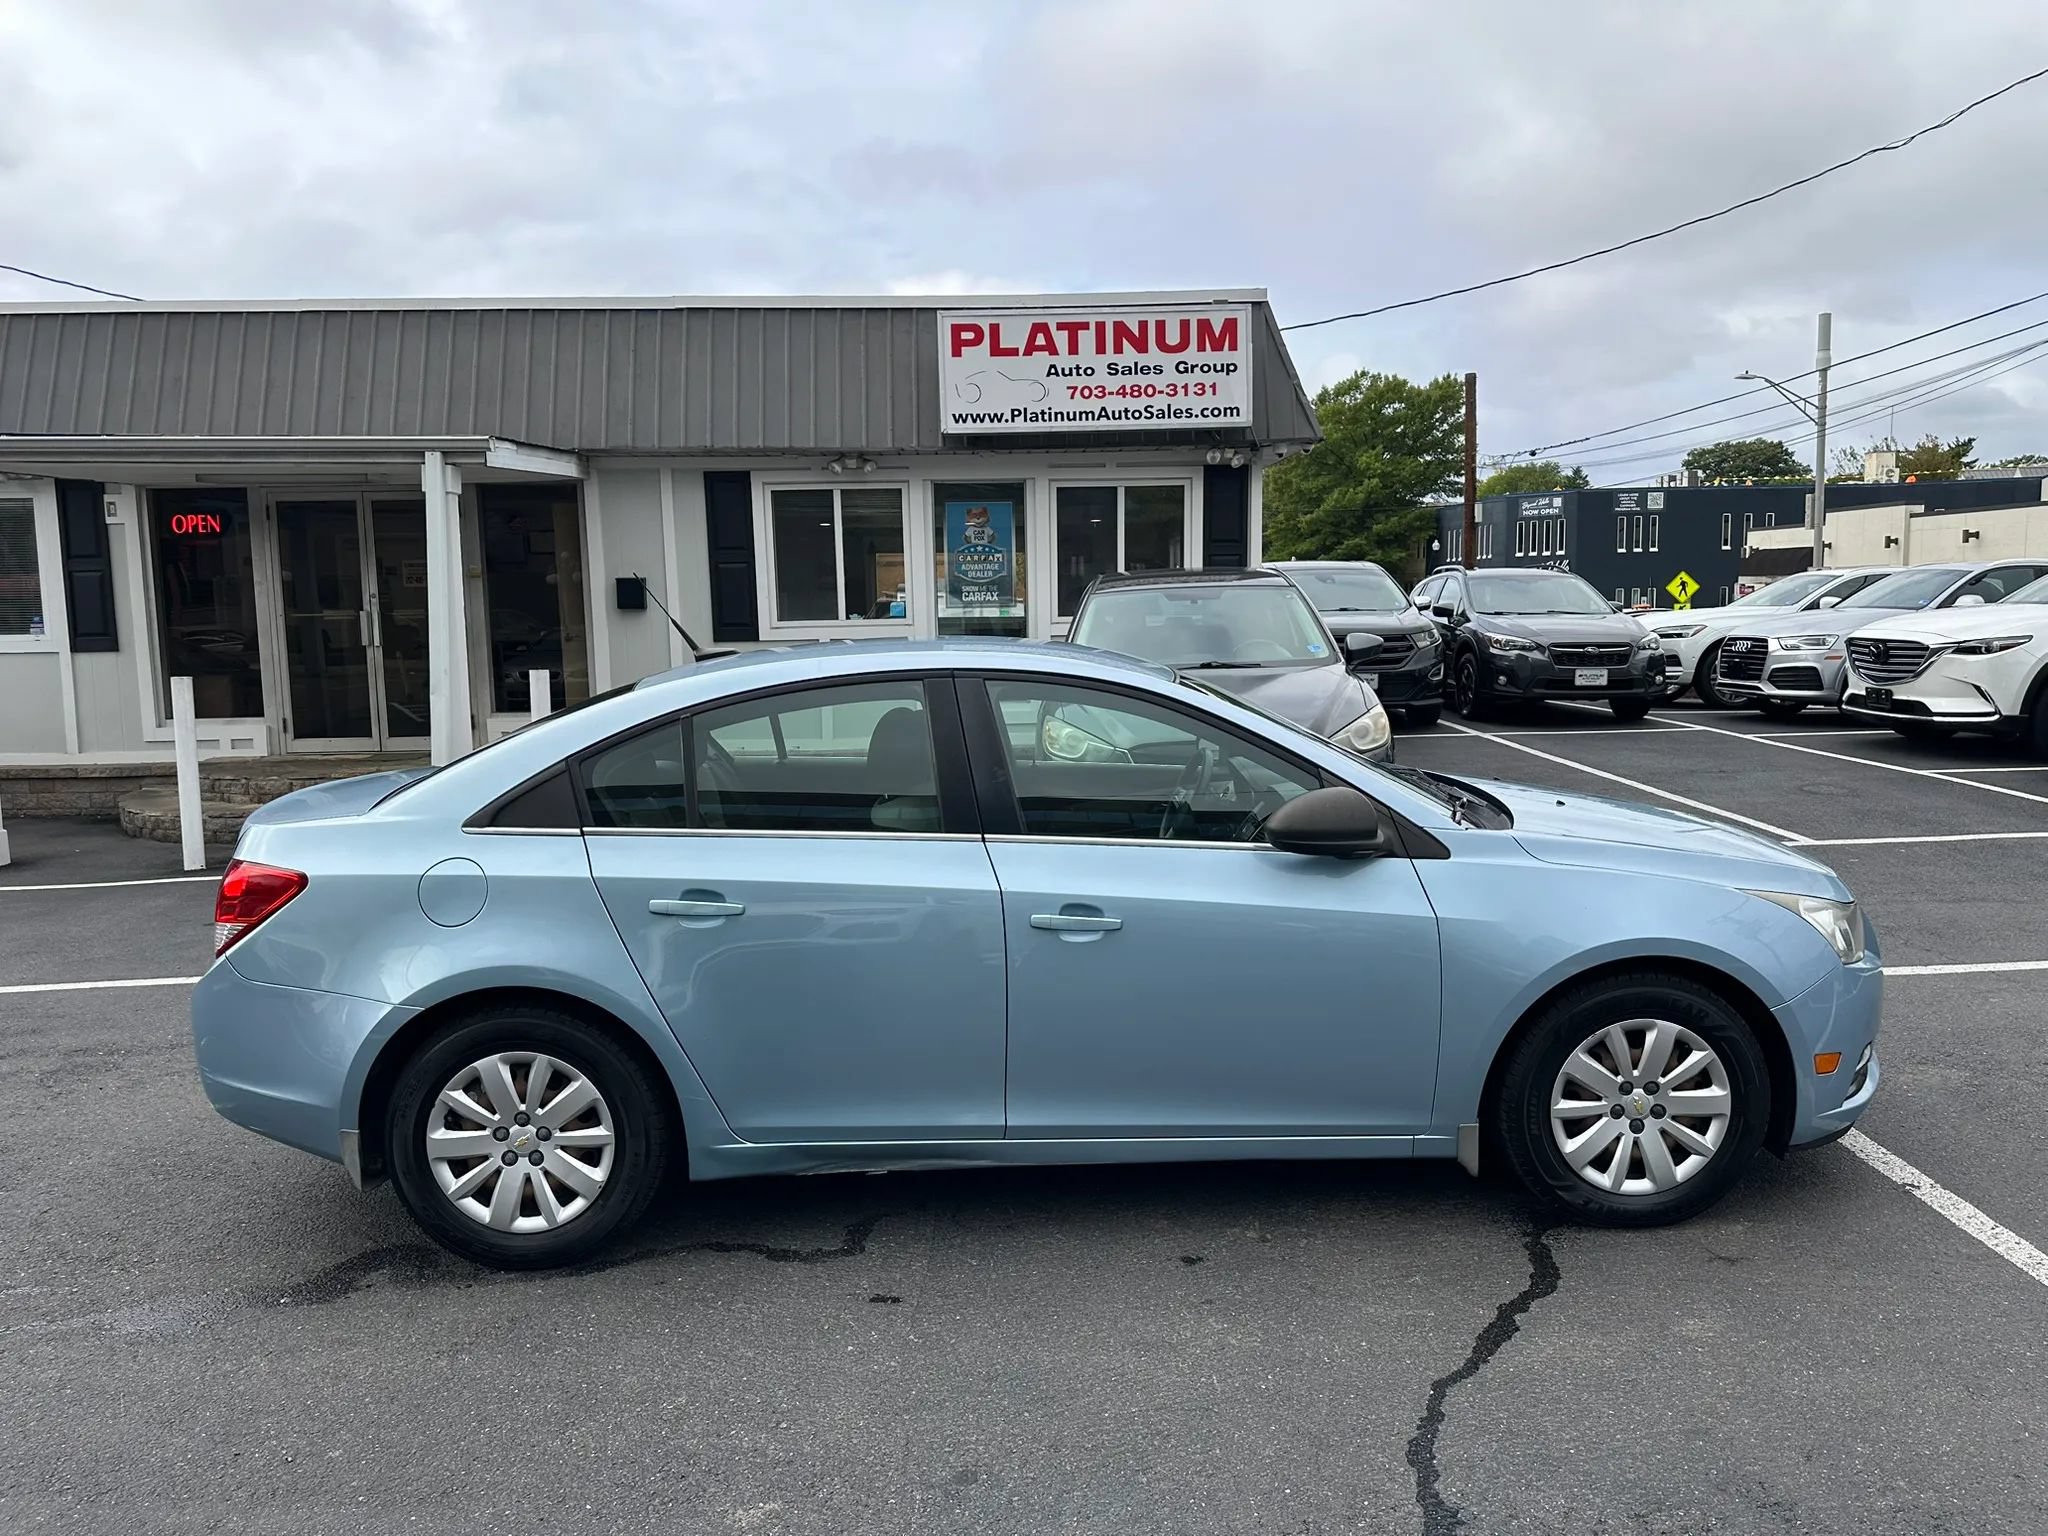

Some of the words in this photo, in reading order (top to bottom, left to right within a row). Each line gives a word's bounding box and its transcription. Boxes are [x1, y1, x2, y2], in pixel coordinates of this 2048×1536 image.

[950, 317, 1239, 358] PLATINUM
[1046, 363, 1095, 378] Auto
[1106, 362, 1164, 377] Sales
[1174, 360, 1238, 377] Group
[1066, 382, 1218, 400] 703-480-3131
[951, 404, 1240, 424] www.PlatinumAutoSales.com
[172, 514, 220, 534] OPEN
[959, 554, 1003, 562] CARFAX
[962, 592, 999, 601] CARFAX
